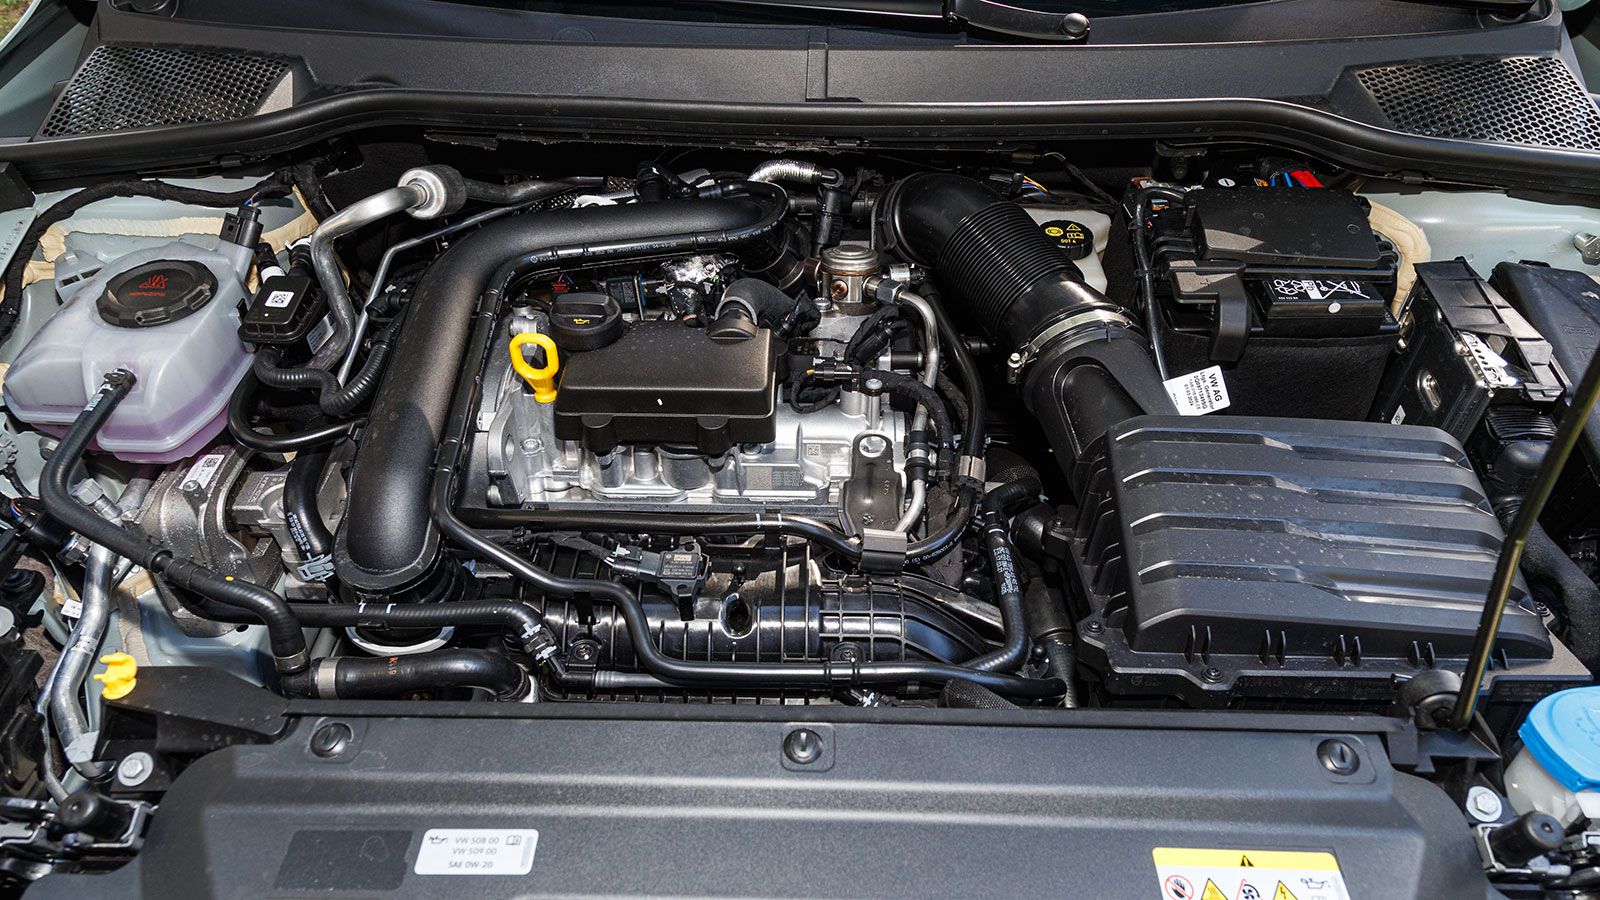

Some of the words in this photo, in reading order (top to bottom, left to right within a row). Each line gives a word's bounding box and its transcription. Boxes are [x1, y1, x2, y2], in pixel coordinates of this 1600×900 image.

[1209, 373, 1219, 387] VW
[1204, 385, 1215, 409] Generator
[1213, 389, 1222, 402] AG
[455, 836, 469, 845] VW
[471, 836, 486, 845] 508
[488, 836, 500, 845] 00
[452, 847, 466, 855] VW
[468, 847, 484, 855] 509
[486, 847, 498, 855] 00
[448, 861, 462, 869] SAE
